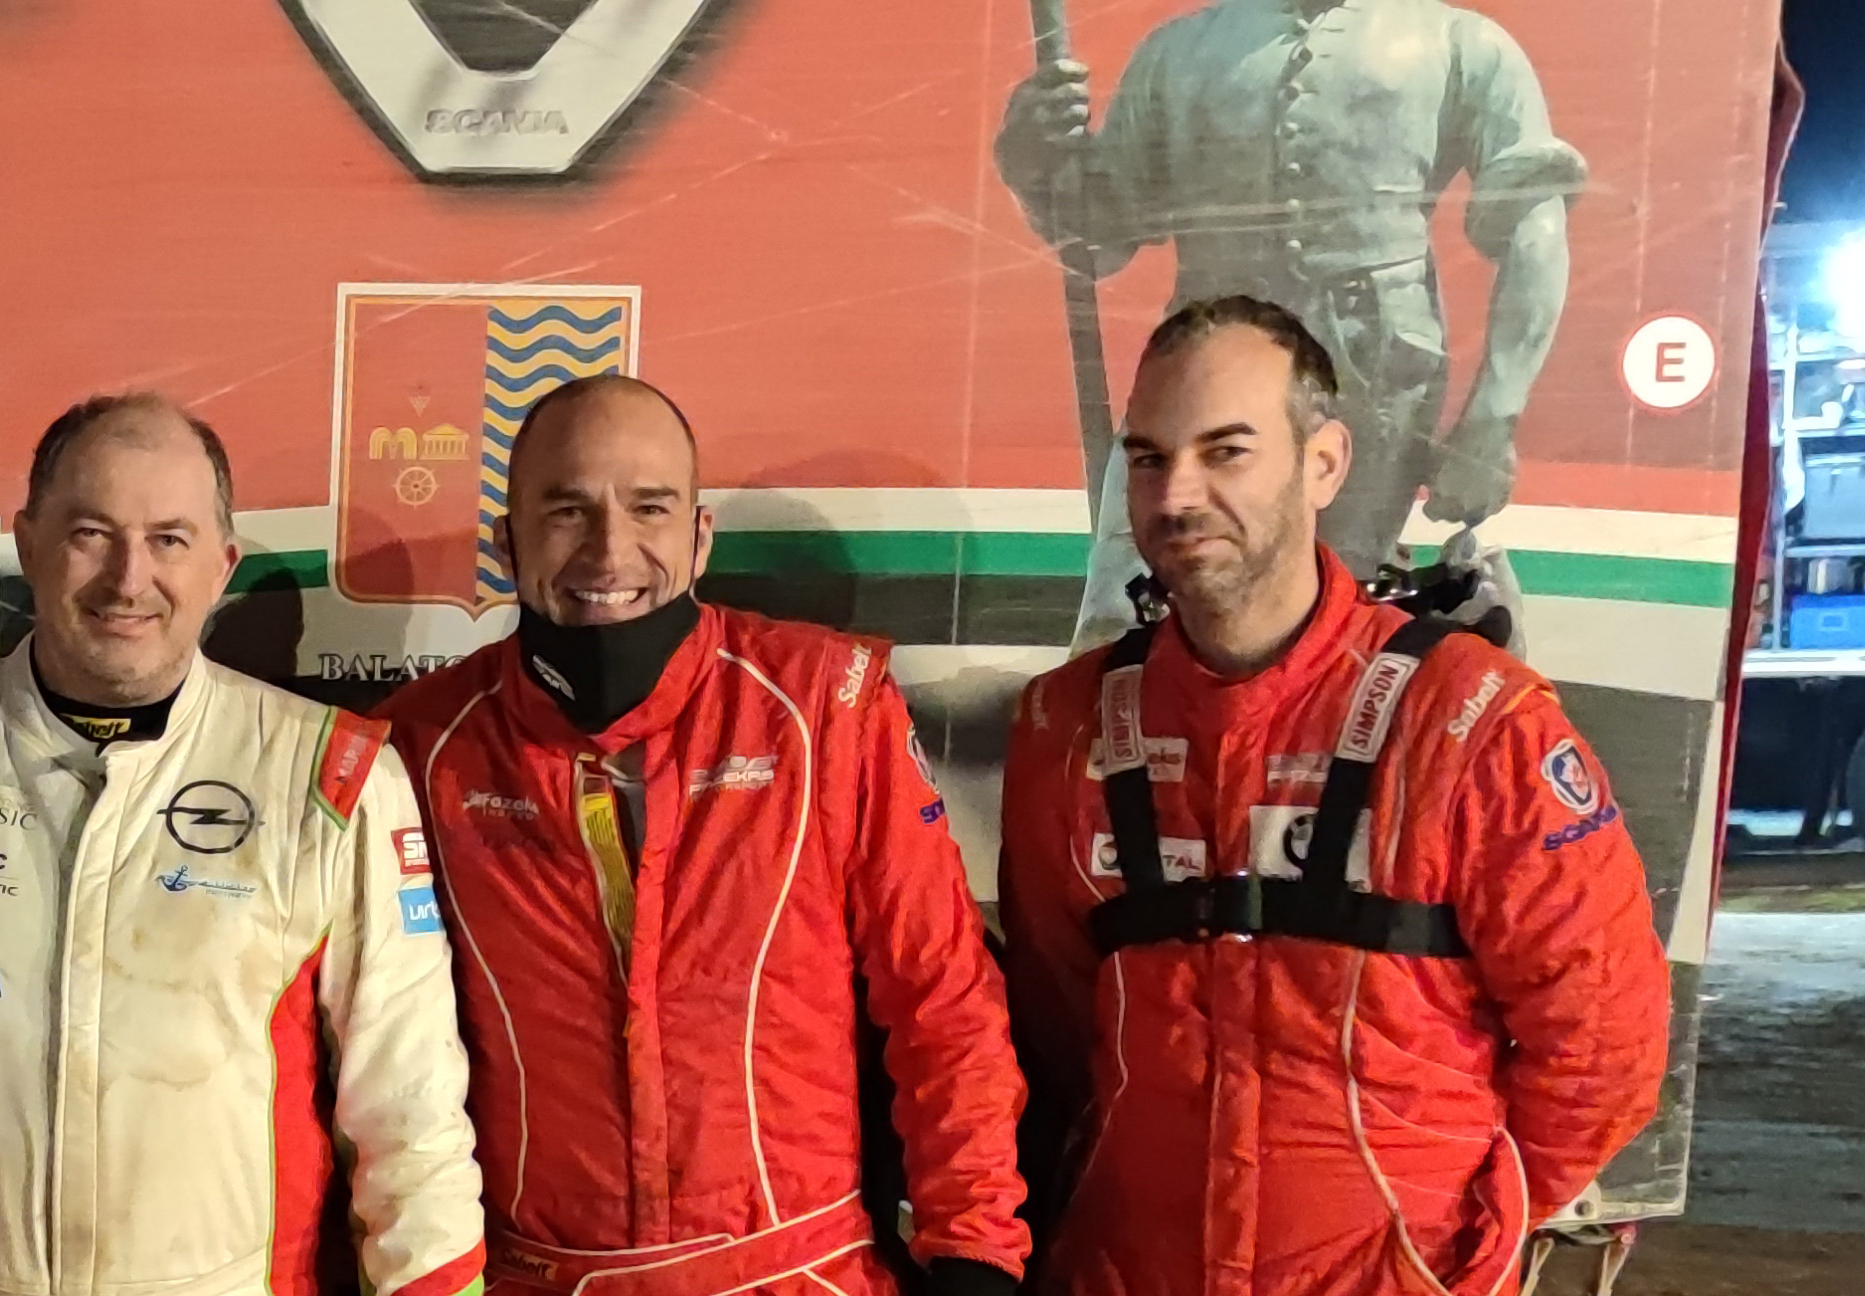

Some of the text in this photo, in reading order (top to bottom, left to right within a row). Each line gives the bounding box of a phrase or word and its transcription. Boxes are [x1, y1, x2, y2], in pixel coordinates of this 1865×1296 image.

[424, 107, 570, 136] SCANIA
[1654, 341, 1687, 383] E
[1351, 664, 1400, 749] SIMPSON
